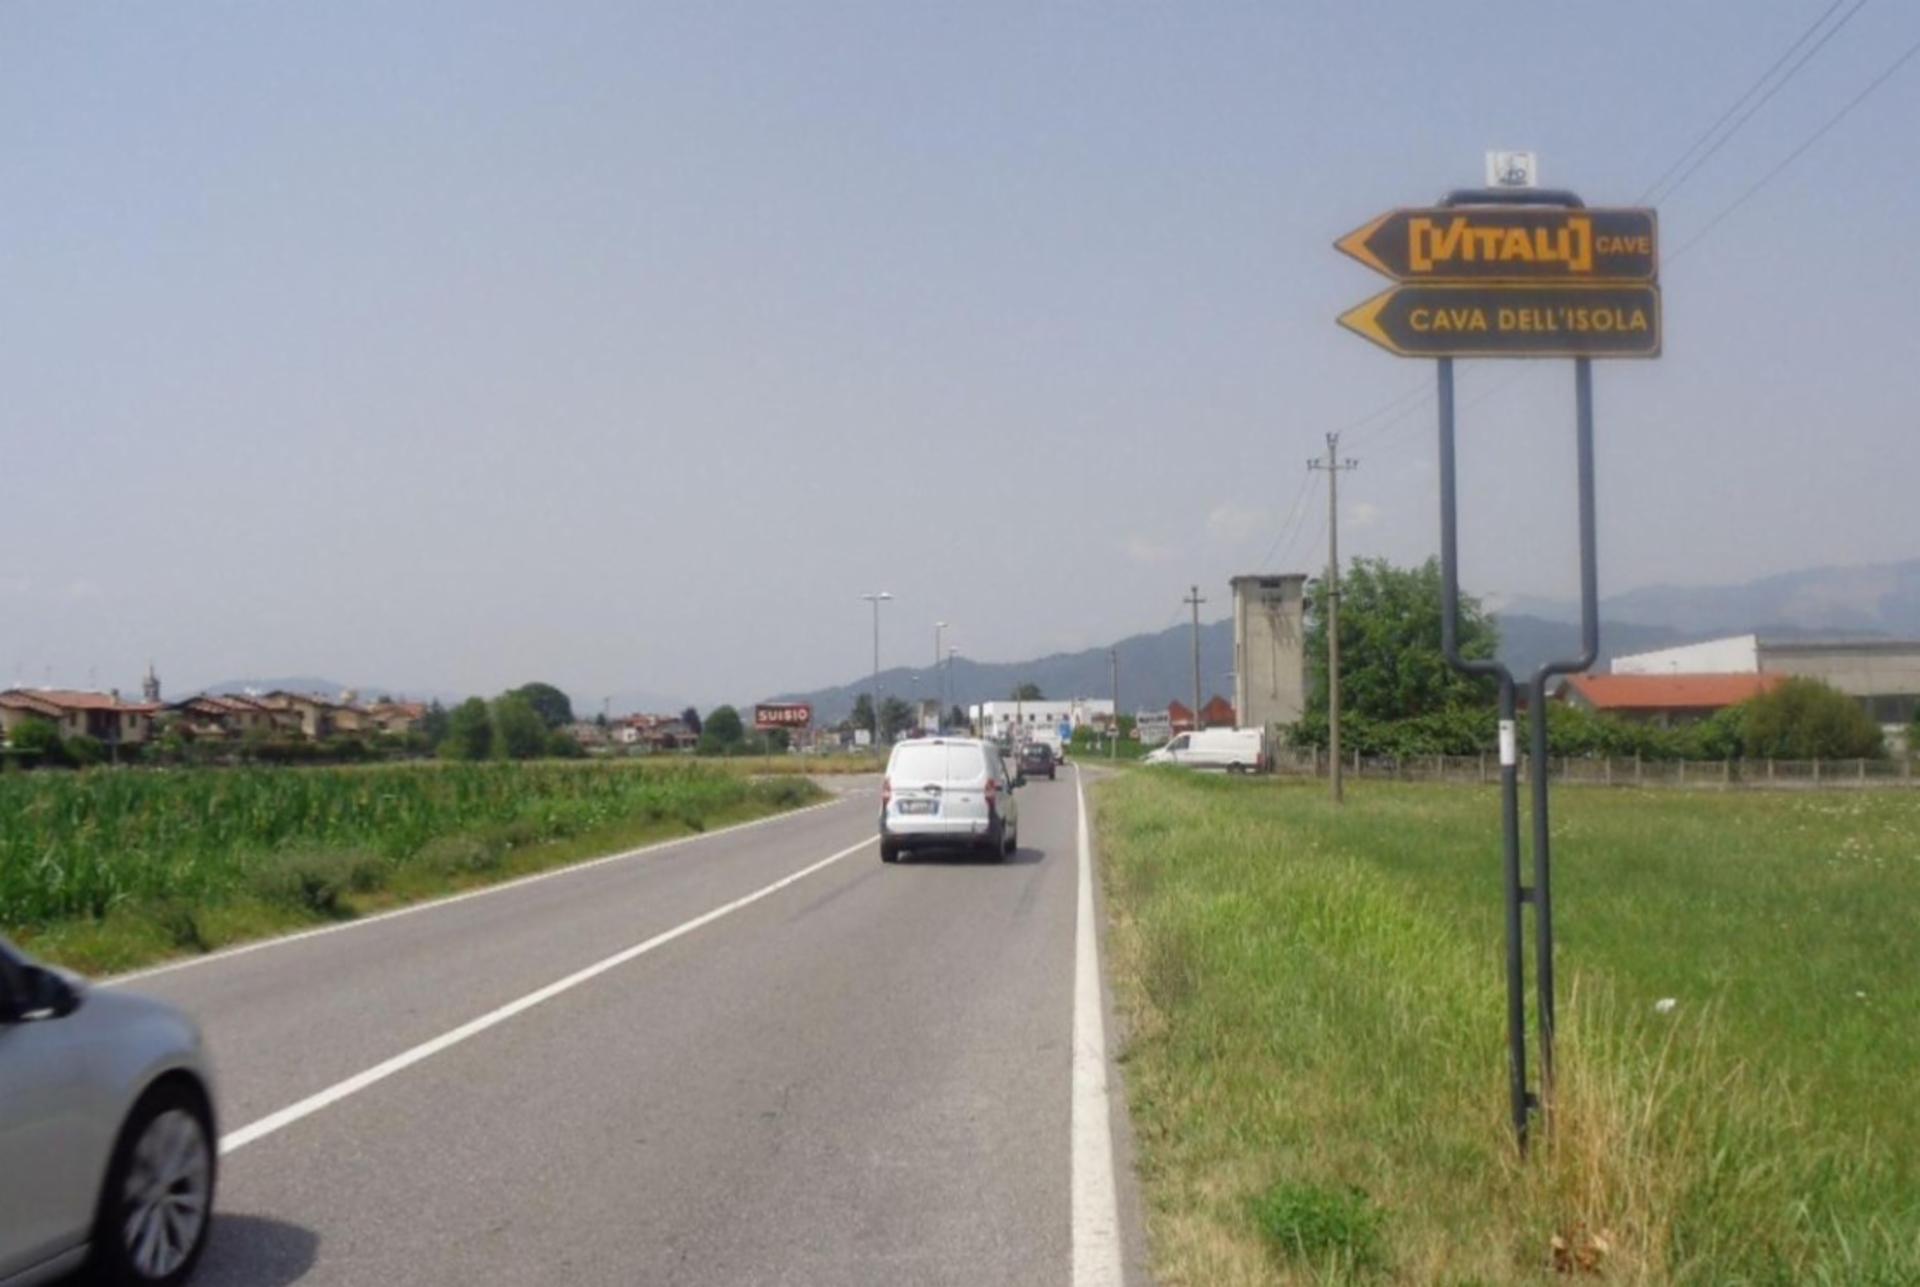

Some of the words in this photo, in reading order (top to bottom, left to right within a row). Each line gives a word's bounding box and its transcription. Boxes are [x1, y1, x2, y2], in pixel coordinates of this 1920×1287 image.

[1595, 235, 1650, 255] CAVE
[1409, 308, 1487, 331] CAVA
[1498, 308, 1648, 331] DELL'ISOLA
